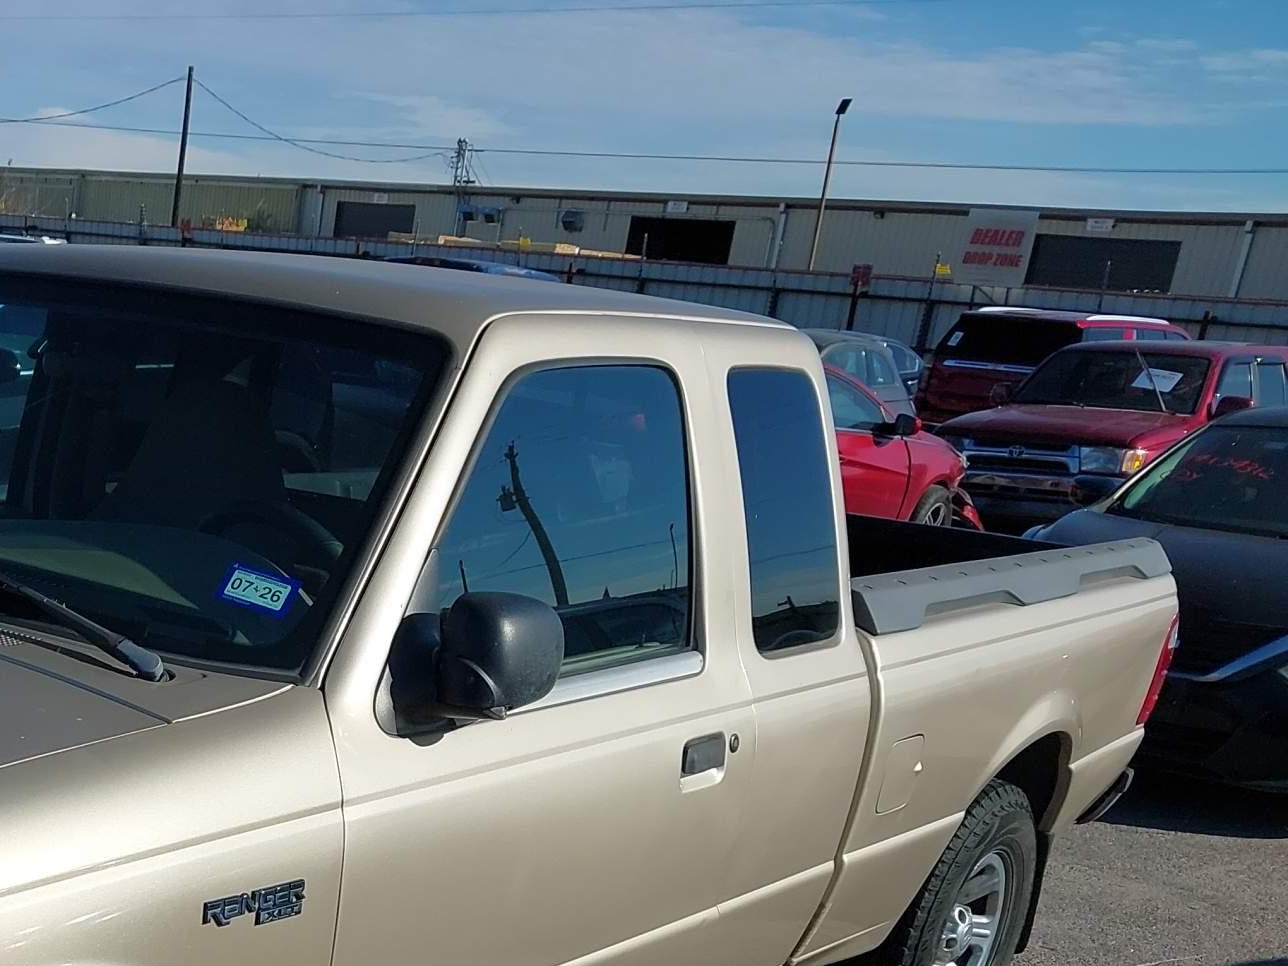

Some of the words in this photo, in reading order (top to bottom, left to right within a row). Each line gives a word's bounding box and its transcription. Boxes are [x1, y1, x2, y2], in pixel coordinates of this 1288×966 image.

[969, 227, 1025, 248] DEALER
[962, 251, 993, 265] DROP
[993, 253, 1023, 267] ZONE
[201, 878, 306, 928] RANGER
